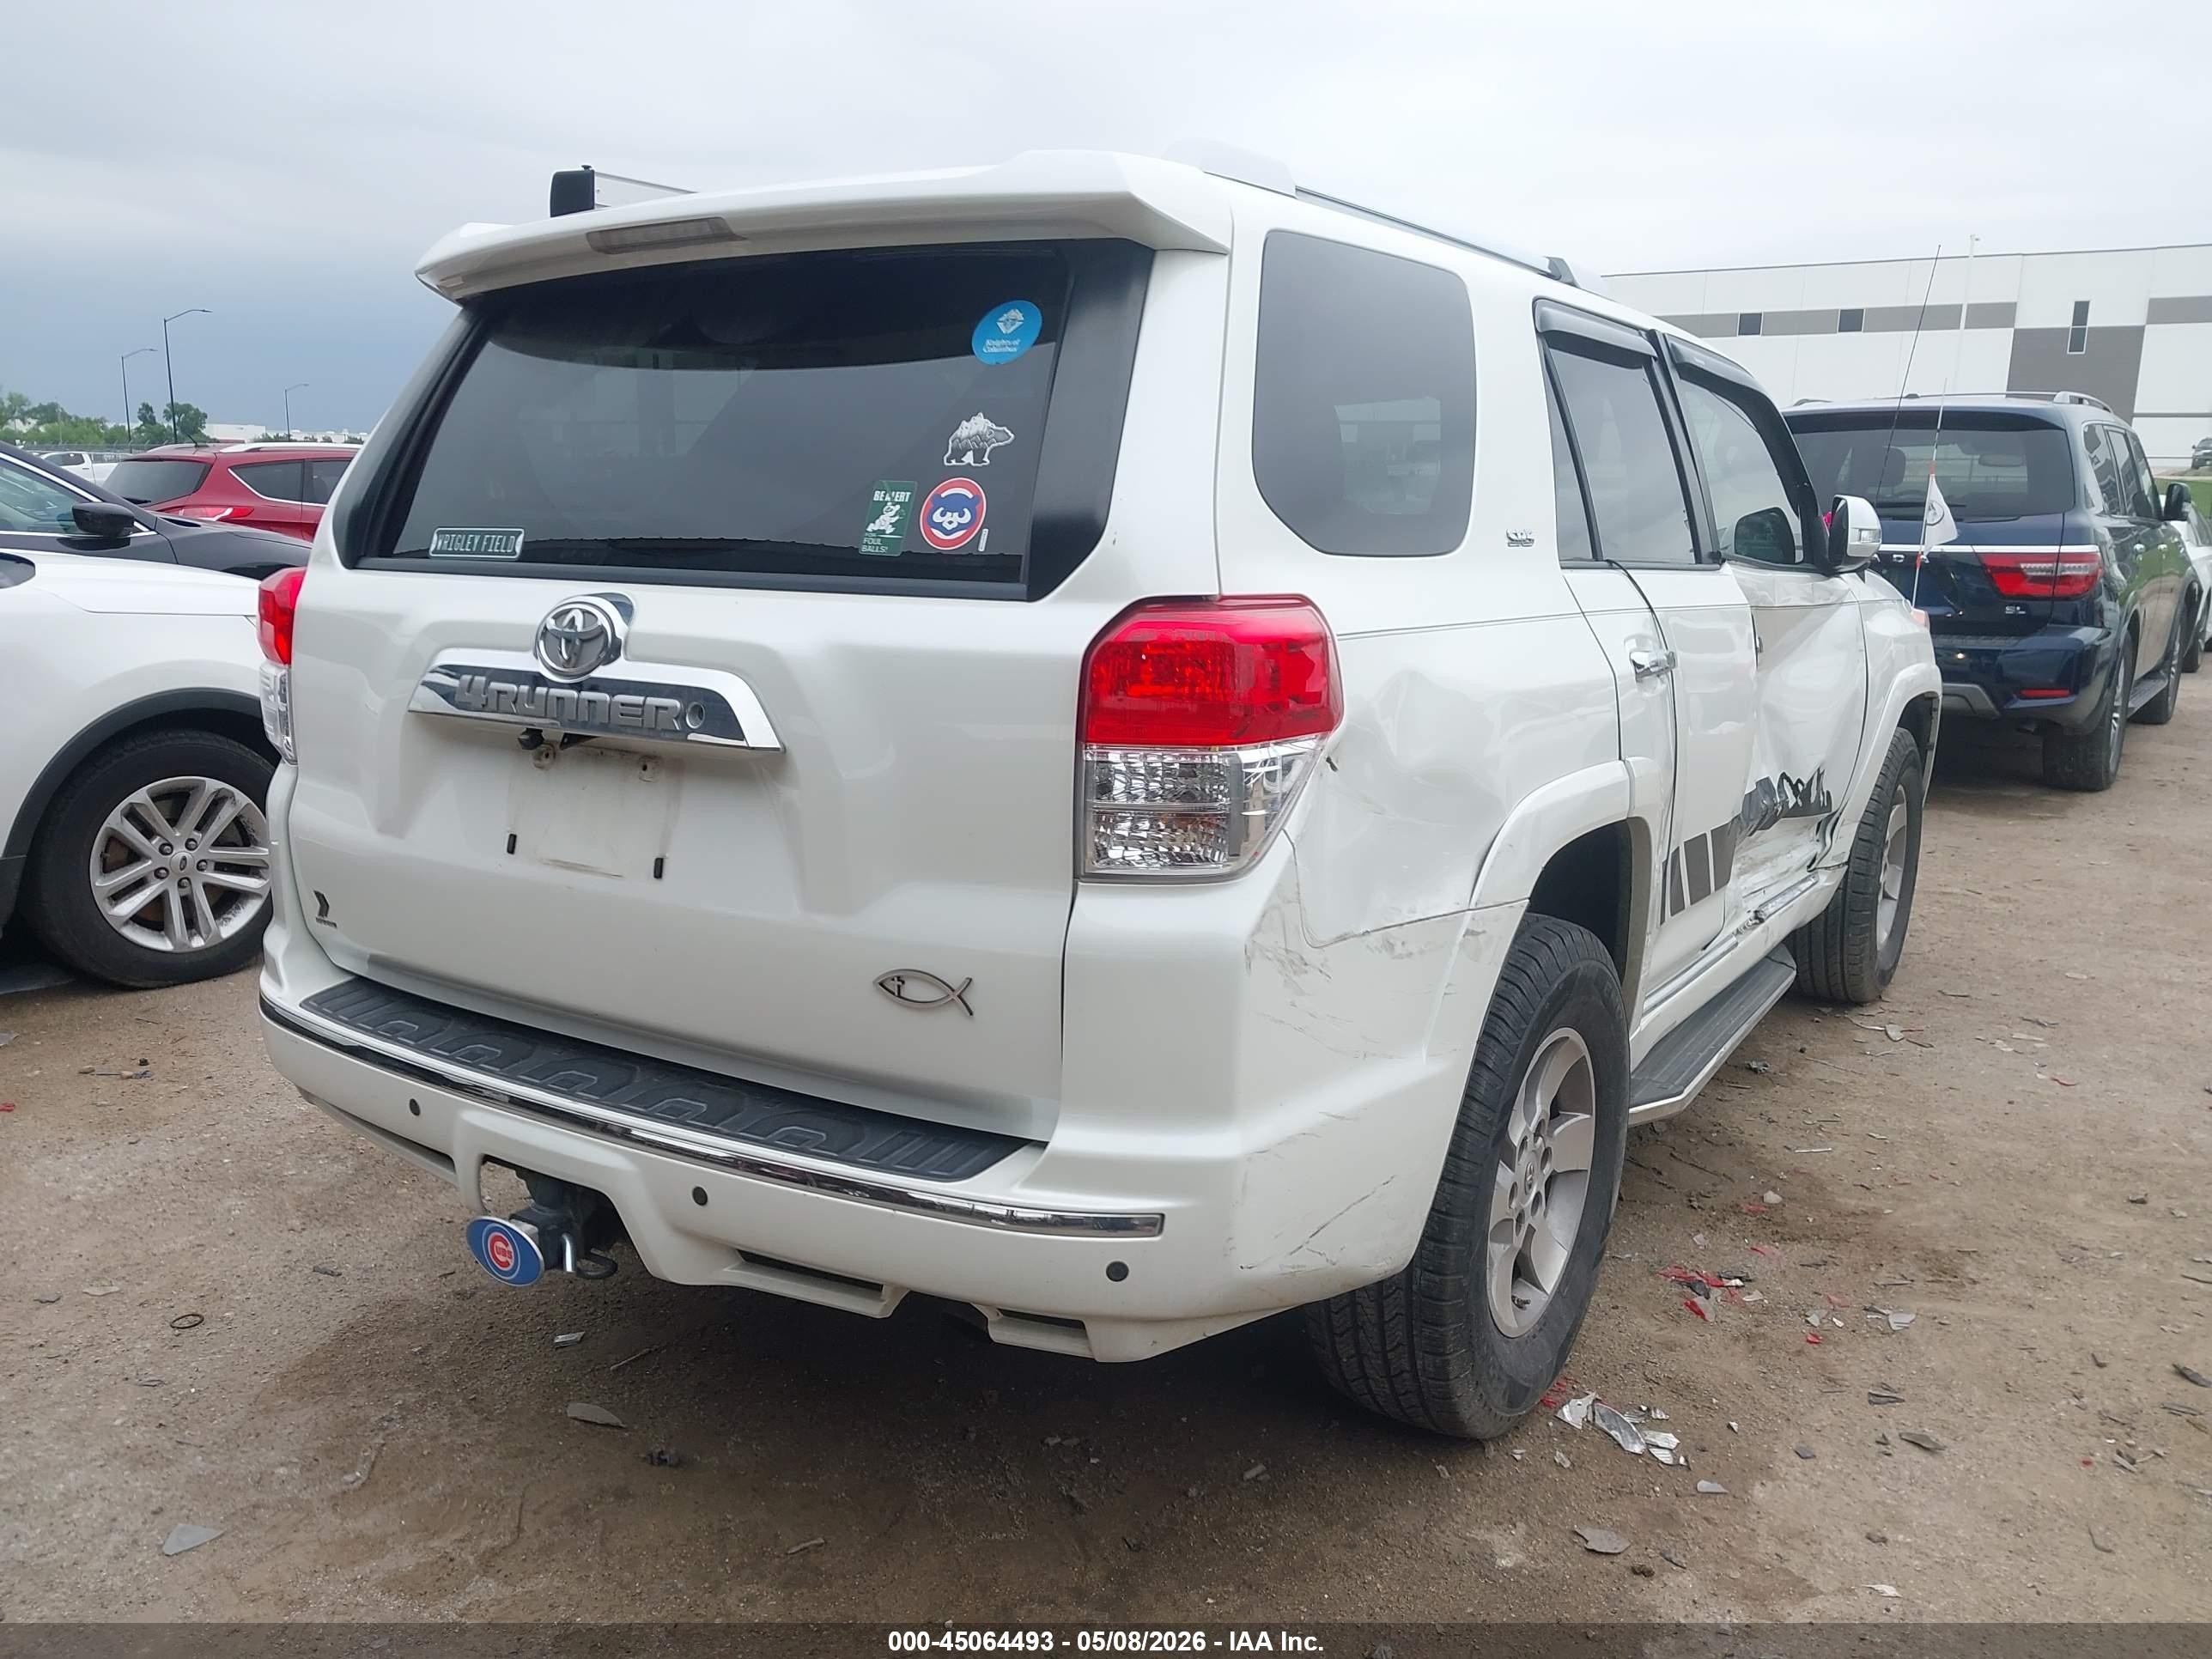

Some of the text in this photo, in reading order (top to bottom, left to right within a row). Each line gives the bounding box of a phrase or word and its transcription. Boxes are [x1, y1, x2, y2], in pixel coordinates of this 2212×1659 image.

[873, 490, 885, 501] BE
[436, 534, 516, 553] WRIGLEY FIELD
[862, 537, 883, 545] FOUL
[2005, 605, 2026, 615] SL
[454, 675, 684, 730] 4RUNNER
